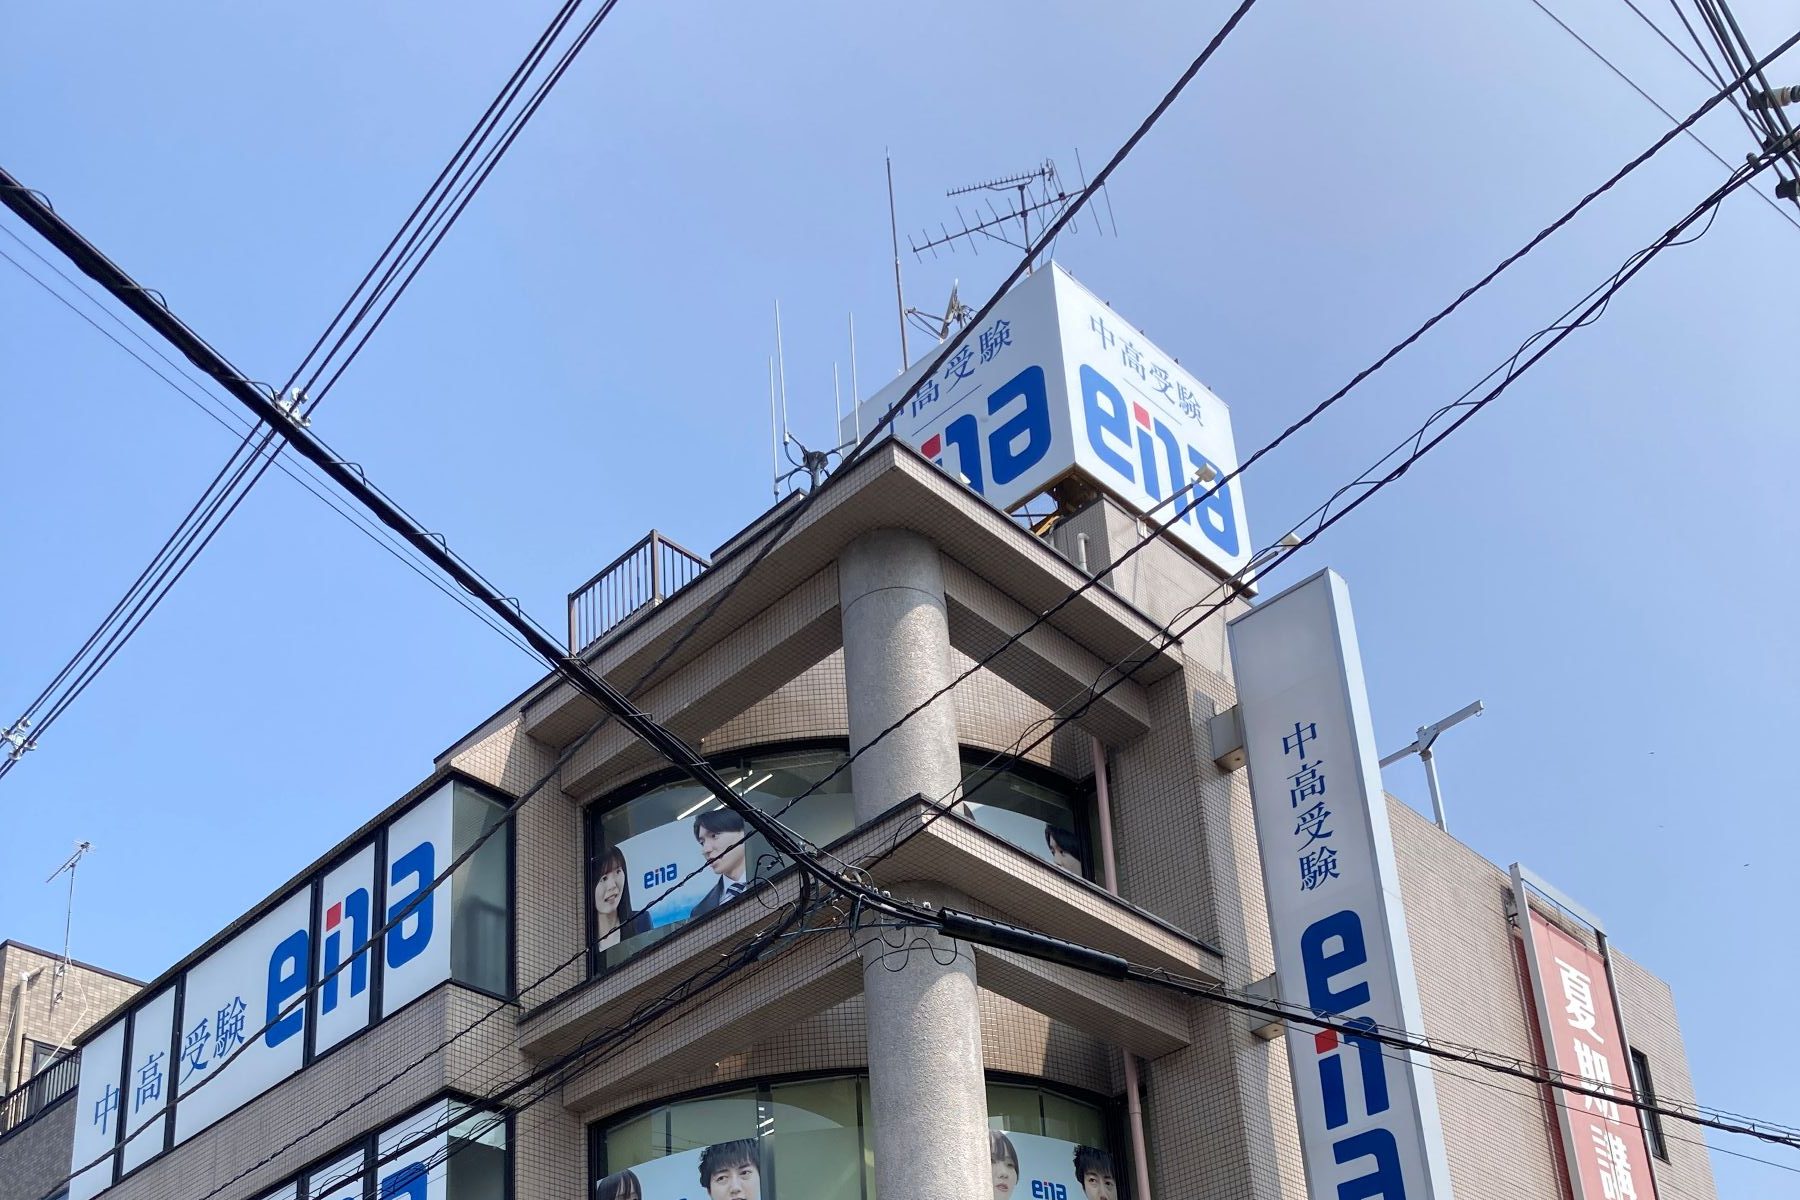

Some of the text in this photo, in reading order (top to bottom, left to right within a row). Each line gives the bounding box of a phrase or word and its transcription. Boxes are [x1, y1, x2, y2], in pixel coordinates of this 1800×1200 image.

[921, 365, 1052, 496] na
[1090, 315, 1204, 427] 中高受験
[1079, 363, 1239, 557] ena
[644, 863, 678, 889] ena
[1282, 722, 1341, 891] 中高受験
[265, 840, 435, 1049] ena
[94, 996, 247, 1135] 中高受験
